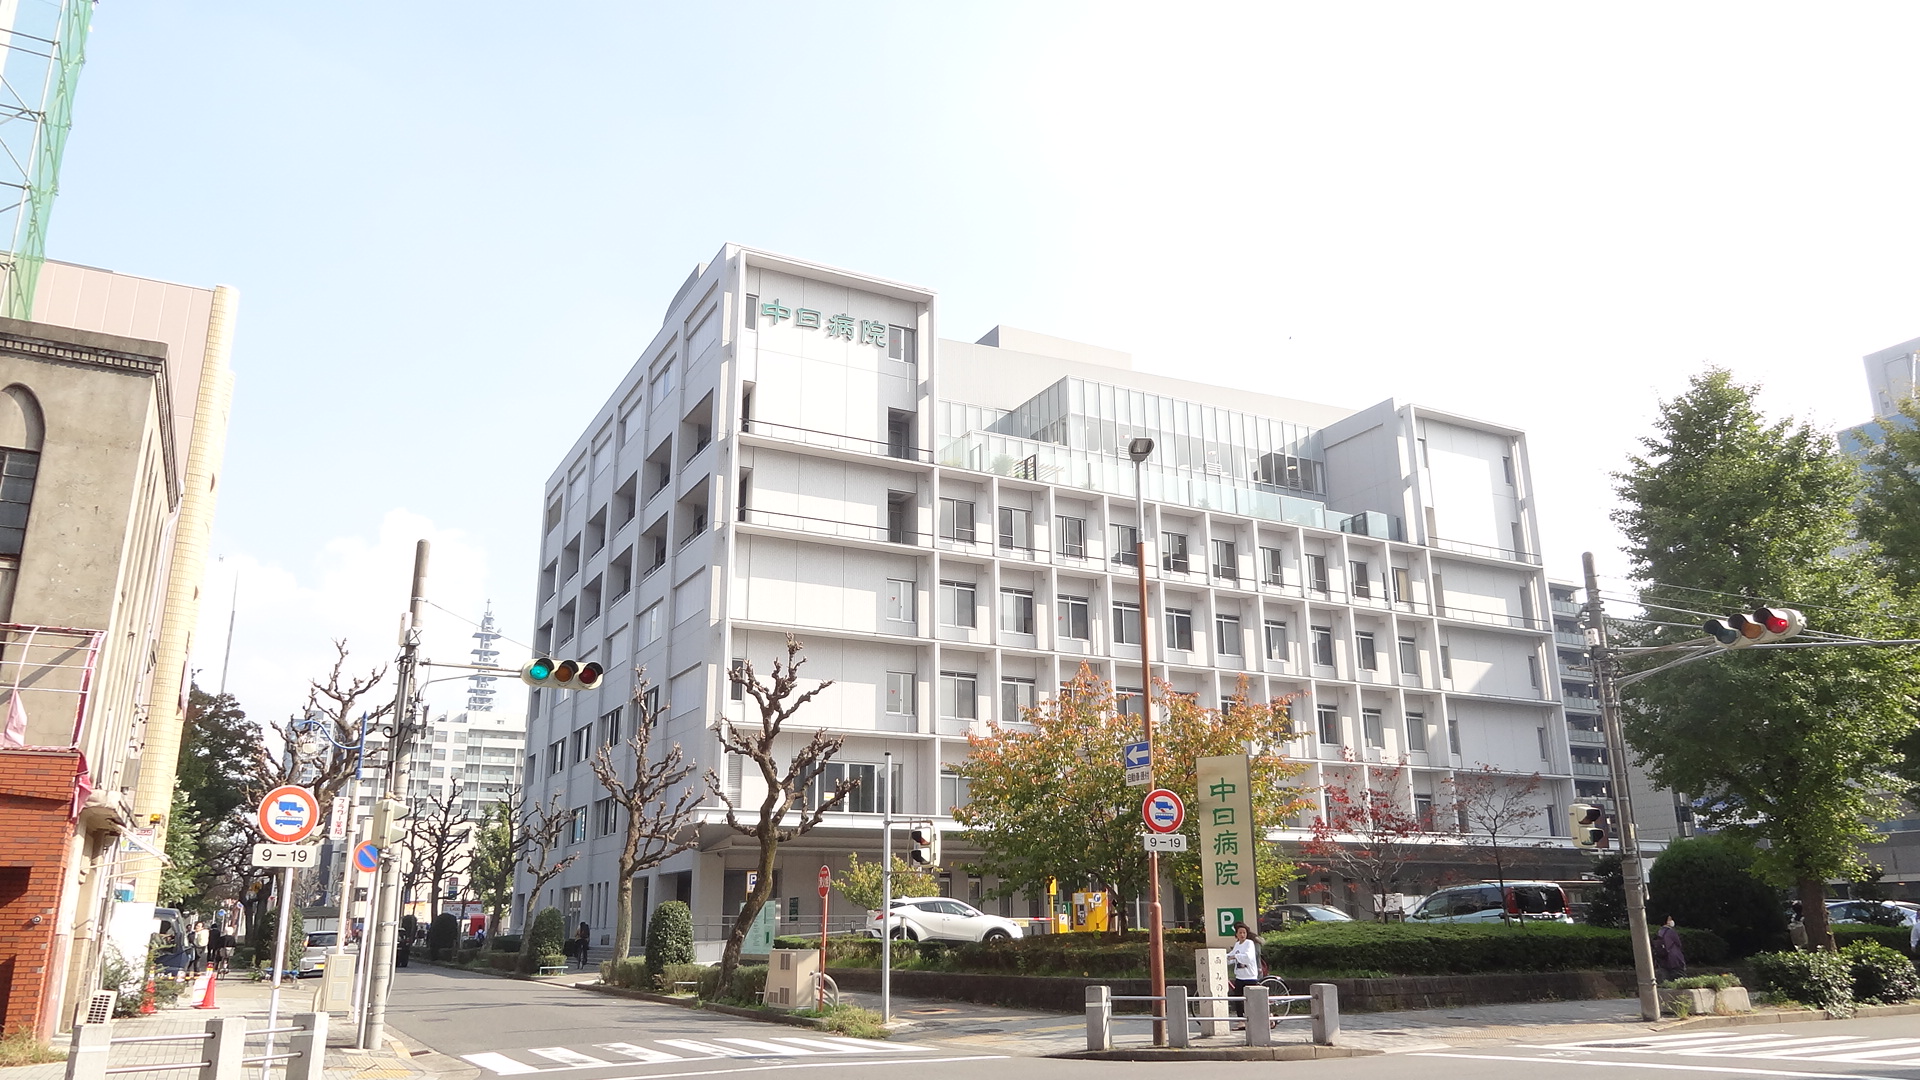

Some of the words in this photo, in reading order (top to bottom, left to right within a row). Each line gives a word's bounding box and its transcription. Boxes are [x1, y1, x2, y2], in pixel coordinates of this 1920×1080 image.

[761, 298, 887, 347] 中日病院
[1209, 777, 1240, 886] 中日病院
[1220, 911, 1235, 933] P
